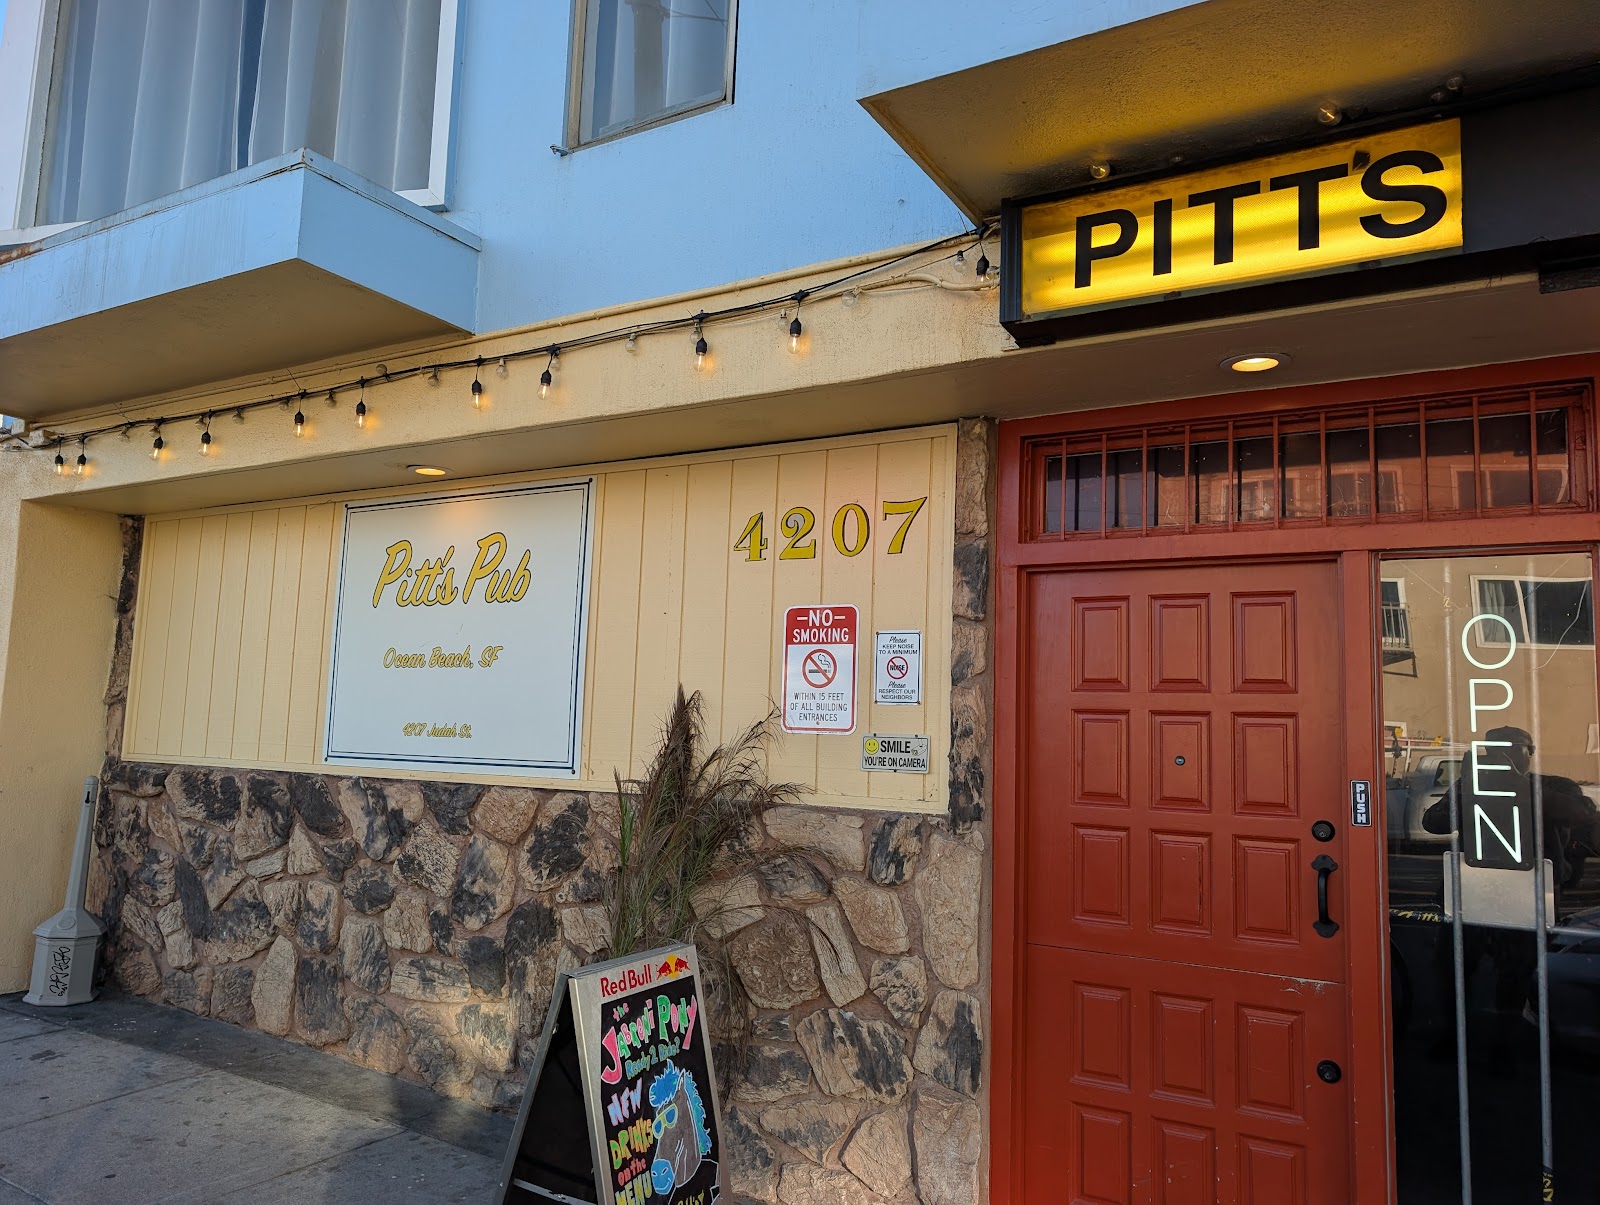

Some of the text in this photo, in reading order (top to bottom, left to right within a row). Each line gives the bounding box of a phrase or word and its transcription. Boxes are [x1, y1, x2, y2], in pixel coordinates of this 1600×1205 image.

[1073, 150, 1448, 289] PITT'S
[733, 496, 928, 562] 4207
[372, 531, 532, 608] Pitt's Pub
[792, 627, 849, 643] SMOKING
[889, 636, 908, 644] Please
[383, 644, 504, 669] Ocean Beach, SF
[888, 680, 907, 689] Please
[794, 692, 845, 701] WITHIN 15 FEET
[790, 702, 848, 712] OF ALL BUILDING
[798, 712, 838, 722] ENTRANCES
[402, 722, 428, 737] 4207
[426, 722, 458, 738] Judah
[1461, 613, 1521, 864] OPEN
[880, 740, 911, 754] SMILE
[864, 756, 926, 769] YOU'RE ON CAMERA
[1355, 783, 1367, 824] PUSH
[600, 963, 653, 998] Red Bull
